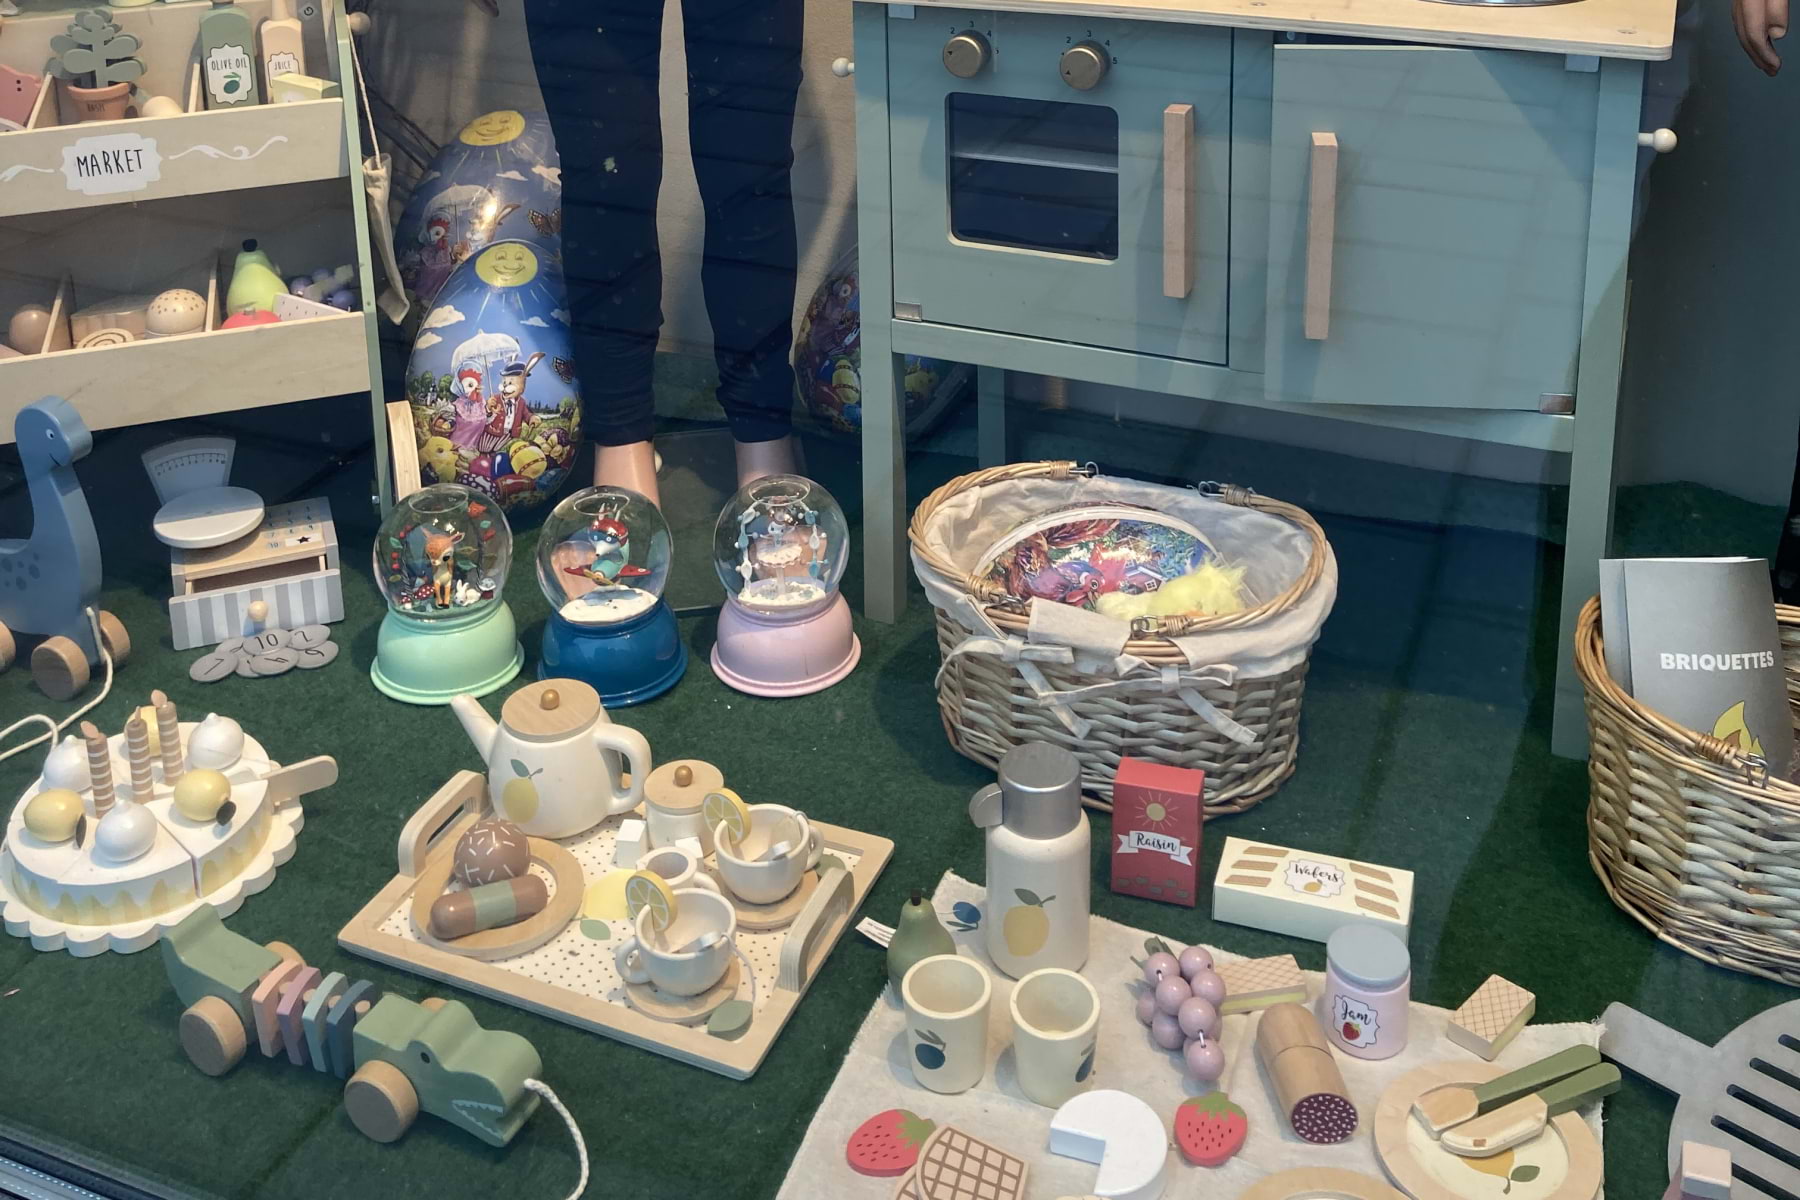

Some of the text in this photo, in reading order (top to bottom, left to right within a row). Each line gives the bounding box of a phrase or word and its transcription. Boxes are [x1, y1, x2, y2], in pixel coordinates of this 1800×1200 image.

[211, 57, 248, 71] OLIVE OIL
[274, 60, 291, 71] JUICE
[76, 148, 143, 178] MARKET
[254, 633, 279, 649] 10
[1660, 650, 1775, 672] BRIQUETTES
[1135, 832, 1177, 852] Raisin
[1294, 863, 1339, 883] Wafers
[1341, 999, 1372, 1026] Jam
